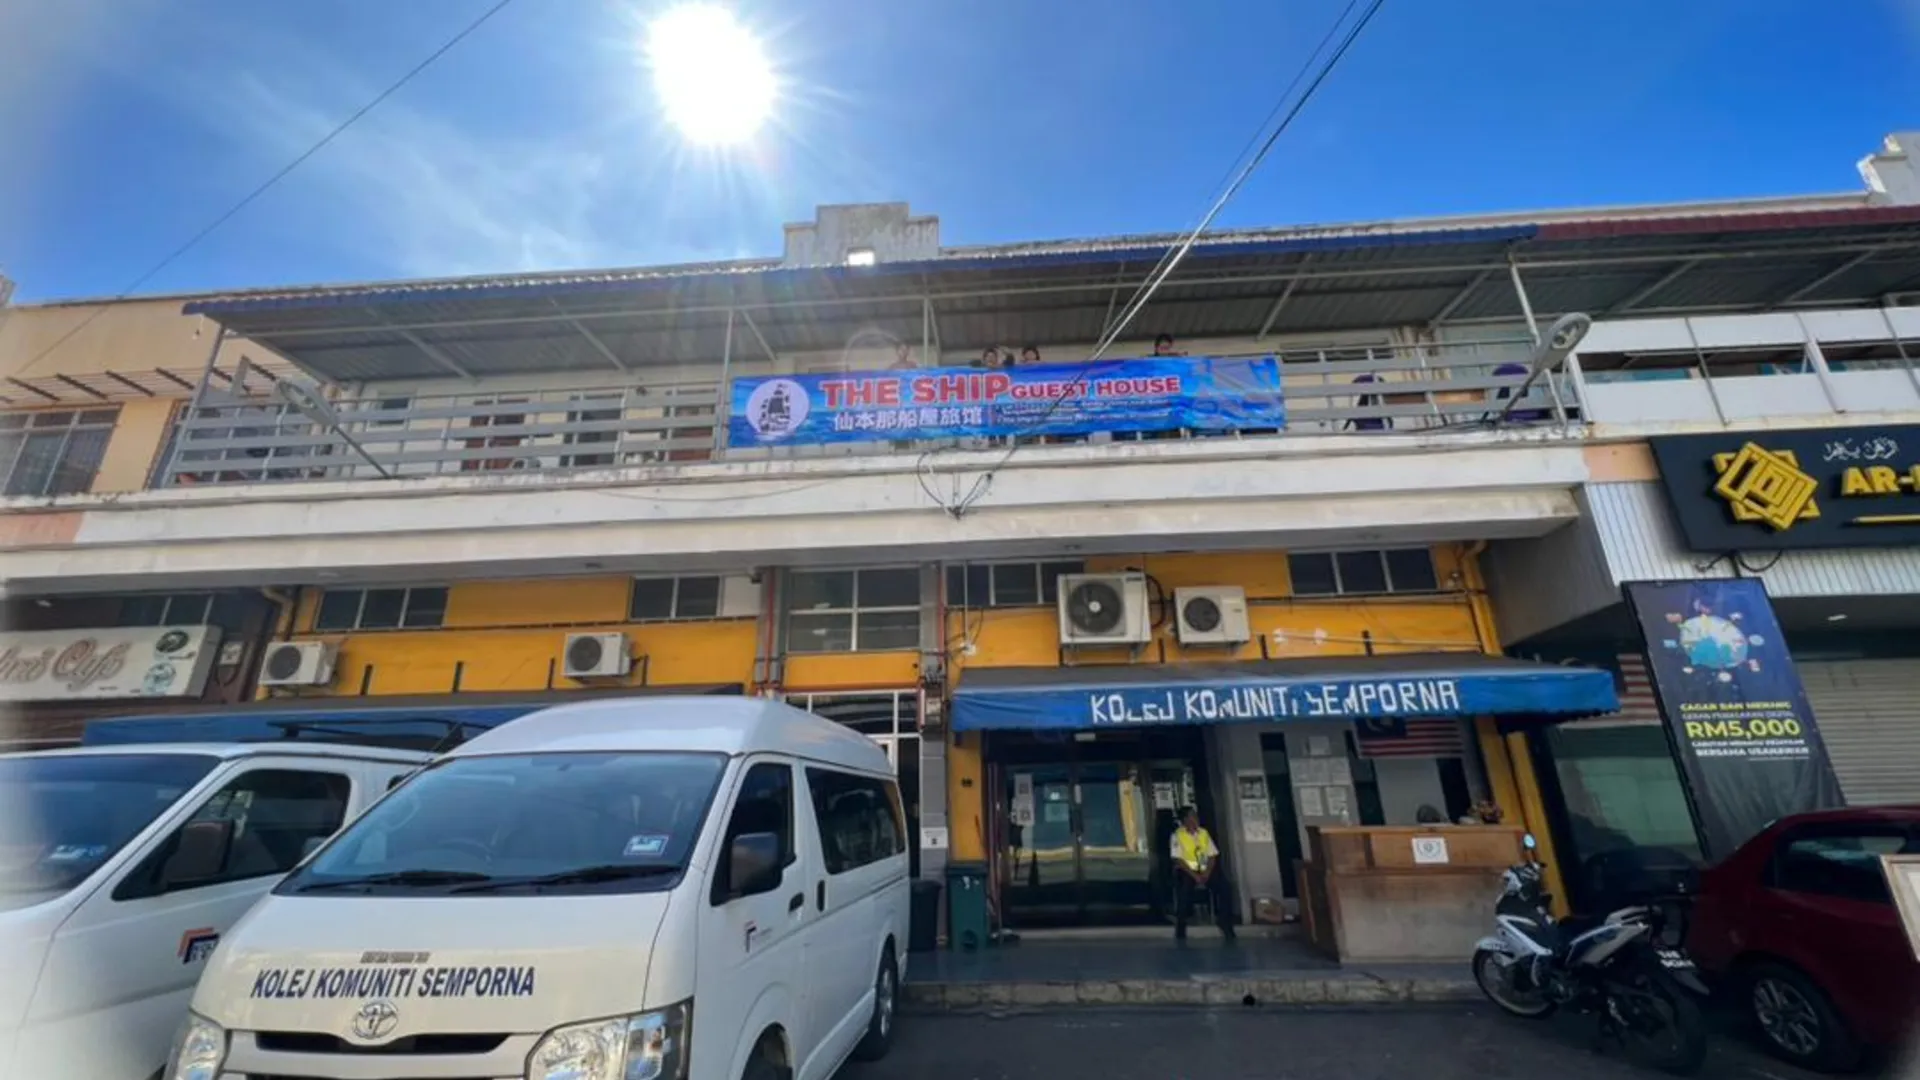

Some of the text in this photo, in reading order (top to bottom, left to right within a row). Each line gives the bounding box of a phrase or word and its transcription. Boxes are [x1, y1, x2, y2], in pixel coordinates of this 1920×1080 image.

[820, 373, 1181, 408] THE SHIP GUEST HOUSE
[833, 405, 982, 432] 仙本那船屋旅馆
[1304, 679, 1460, 716] SEMPORNA
[1685, 719, 1801, 740] RM5,000
[250, 966, 536, 998] KOLEJ KOMUNITI SEMPORNA
